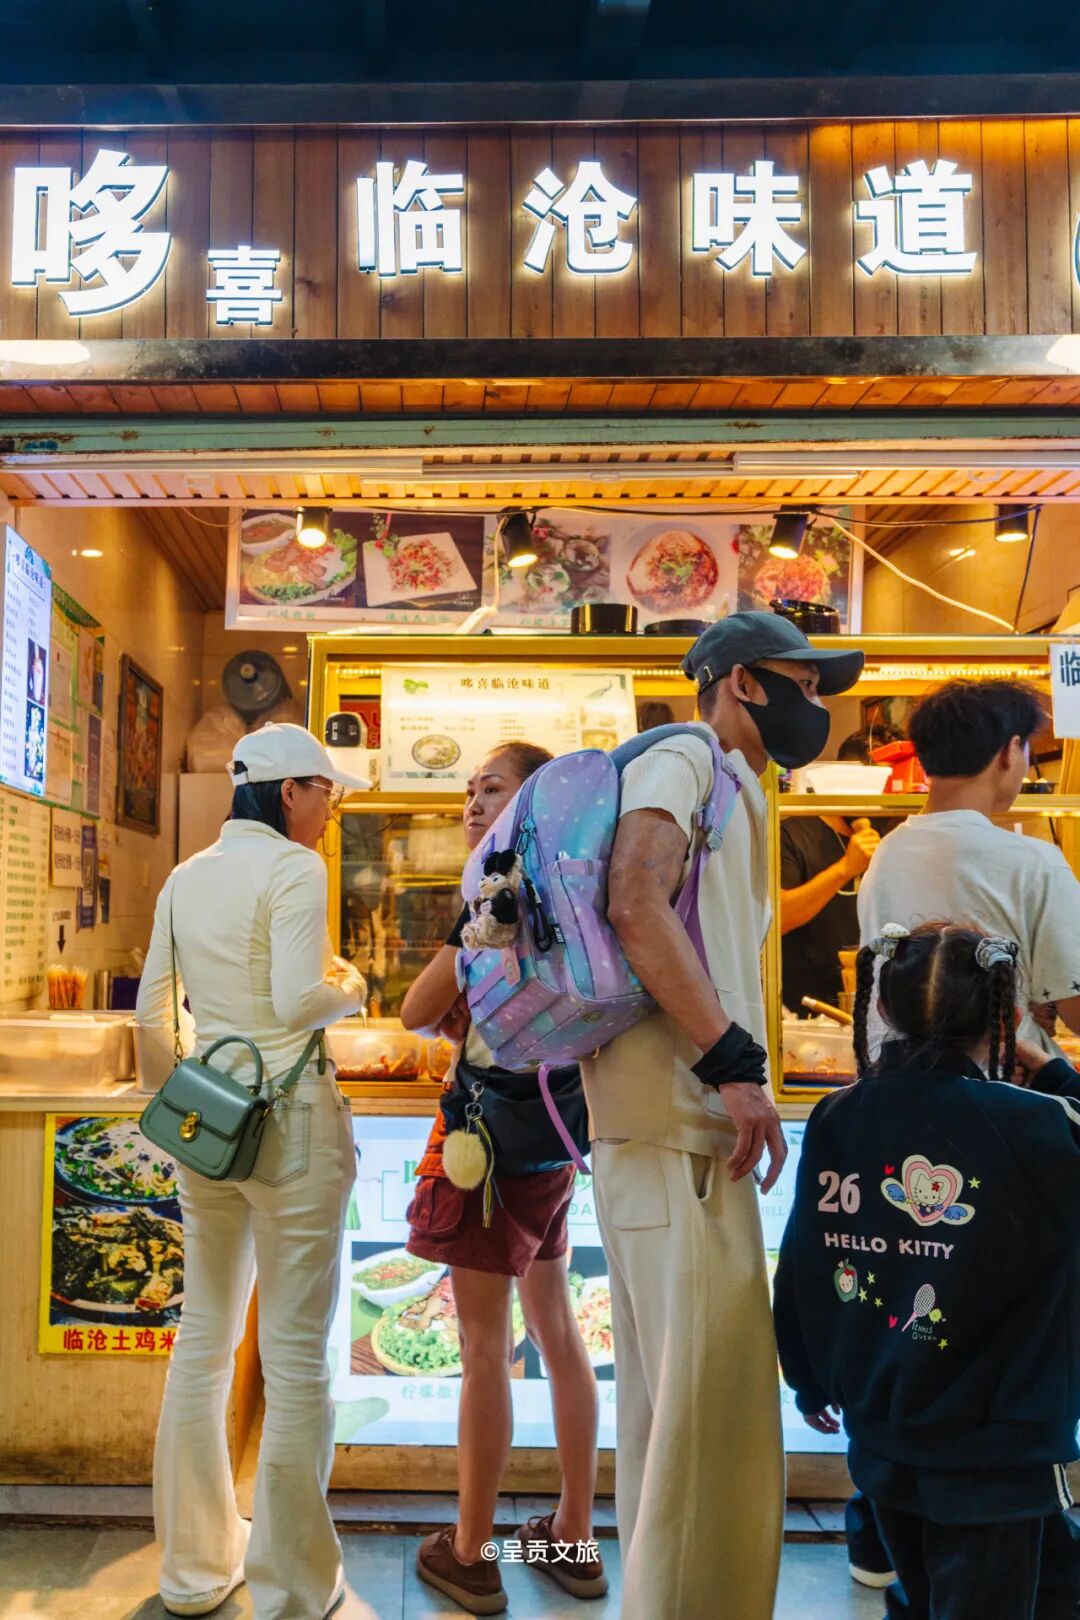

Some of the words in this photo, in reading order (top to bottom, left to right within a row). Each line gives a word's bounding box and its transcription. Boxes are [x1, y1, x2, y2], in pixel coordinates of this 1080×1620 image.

[460, 677, 550, 690] 哆喜临沧味道
[817, 1170, 861, 1214] 26
[824, 1232, 888, 1253] HELLO
[899, 1238, 954, 1260] KITTY
